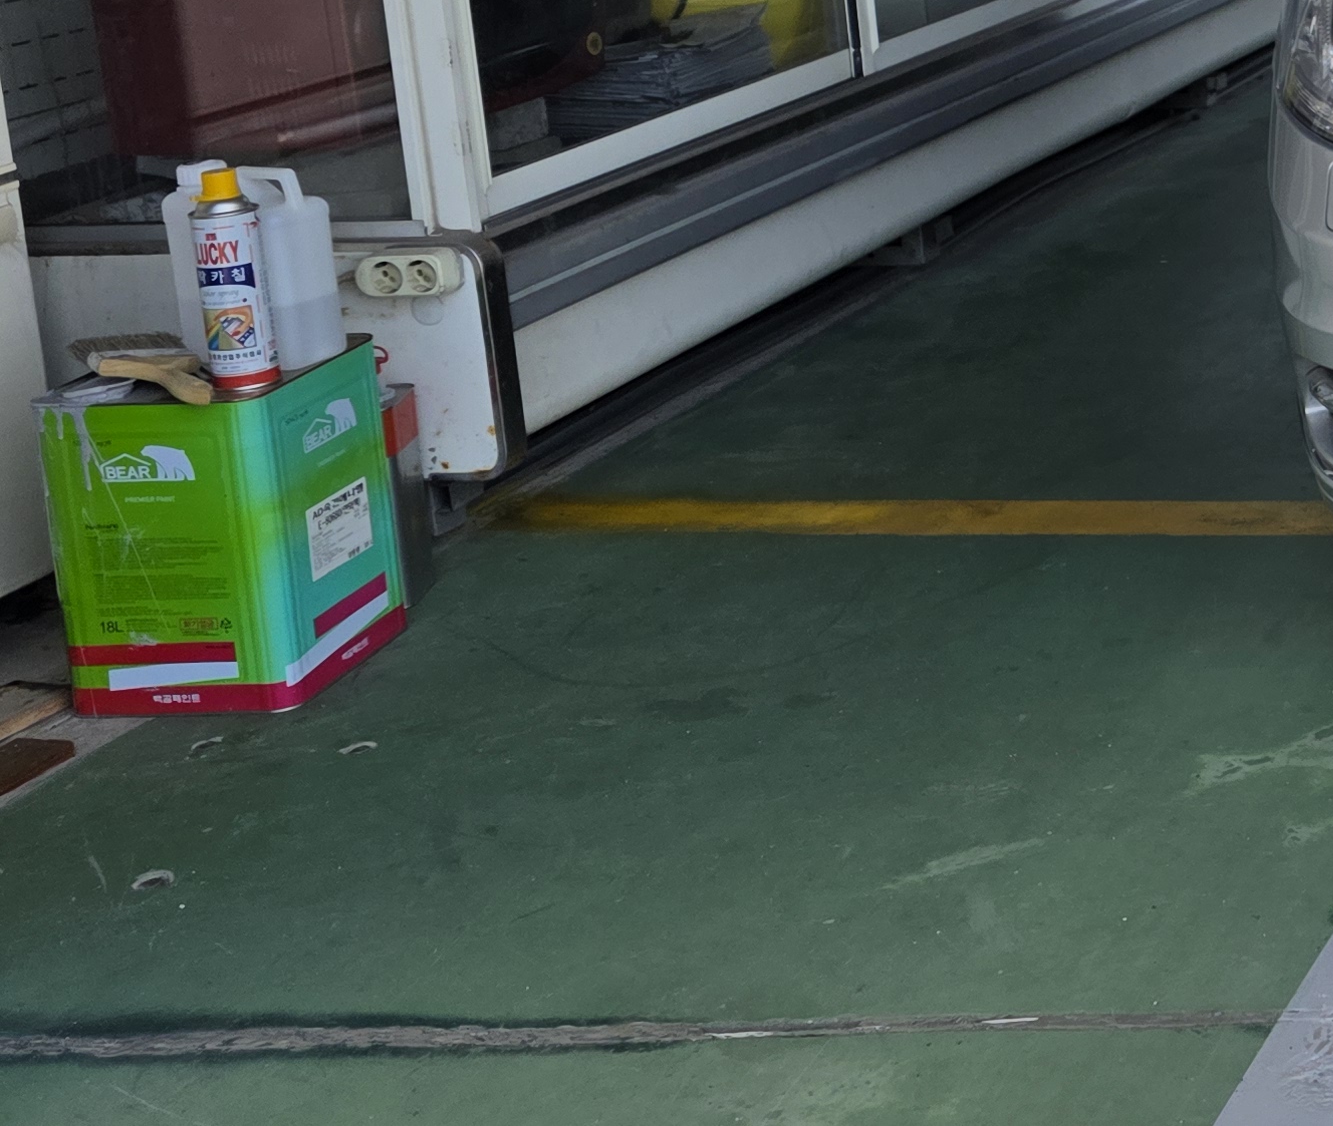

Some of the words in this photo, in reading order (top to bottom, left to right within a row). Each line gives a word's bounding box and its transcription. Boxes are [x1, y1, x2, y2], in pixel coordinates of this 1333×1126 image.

[195, 240, 239, 266] LUCKY
[305, 424, 333, 451] BEAR
[105, 466, 151, 479] BEAR
[100, 621, 124, 634] 18L
